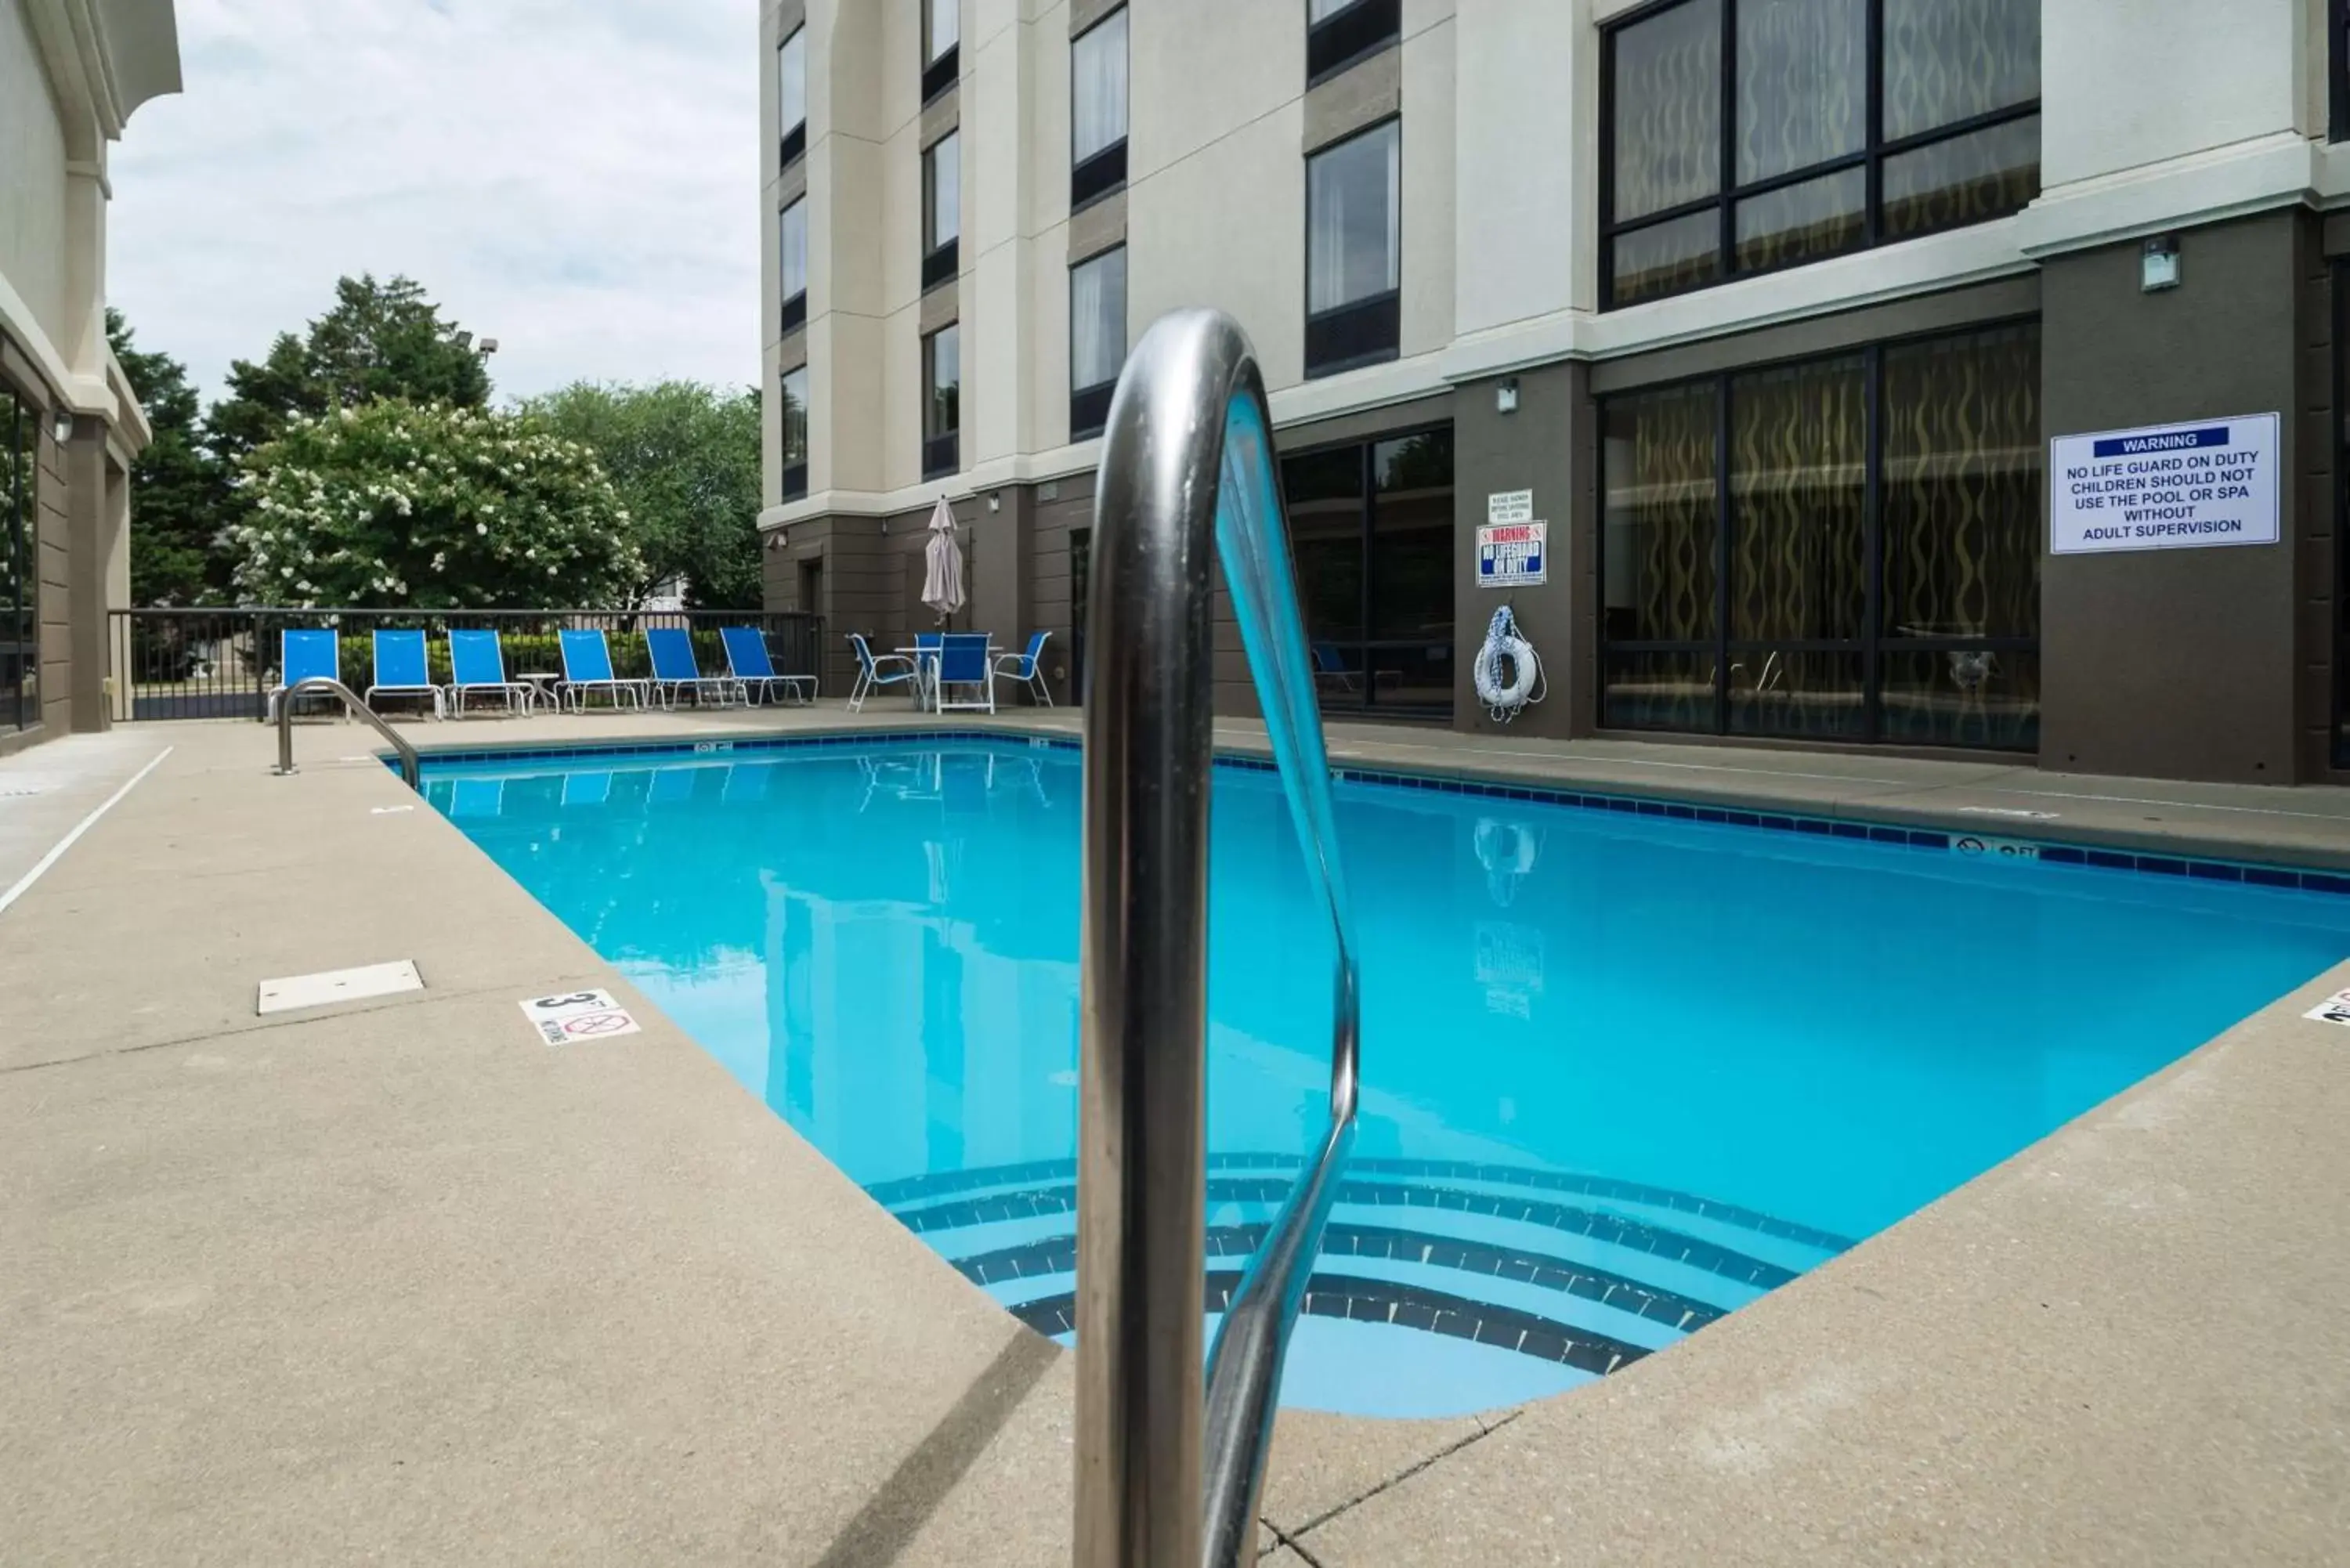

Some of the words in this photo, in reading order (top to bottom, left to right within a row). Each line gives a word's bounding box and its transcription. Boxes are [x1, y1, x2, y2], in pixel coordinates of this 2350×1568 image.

[2123, 433, 2197, 453] WARNING
[2067, 467, 2088, 479] NO
[2092, 464, 2123, 478] LIFE
[2128, 458, 2183, 475] GUARD
[2187, 455, 2211, 468] ON
[2215, 450, 2259, 467] DUTY
[2071, 477, 2146, 494] CHILDREN
[2150, 471, 2216, 488] SHOULD
[2221, 468, 2255, 482] NOT
[2075, 494, 2104, 510] USE
[2109, 490, 2138, 508] THE
[2142, 488, 2186, 505] POOL
[2189, 487, 2213, 502] OR
[2218, 485, 2250, 500] SPA
[2124, 505, 2196, 522] WITHOUT
[1492, 526, 1531, 543] WARNING
[2083, 526, 2131, 540] ADULT
[2136, 519, 2242, 537] SUPERVISION
[1483, 545, 1494, 560] NO
[1494, 559, 1505, 574] ON
[1507, 557, 1528, 573] DUTY
[536, 992, 598, 1008] 3
